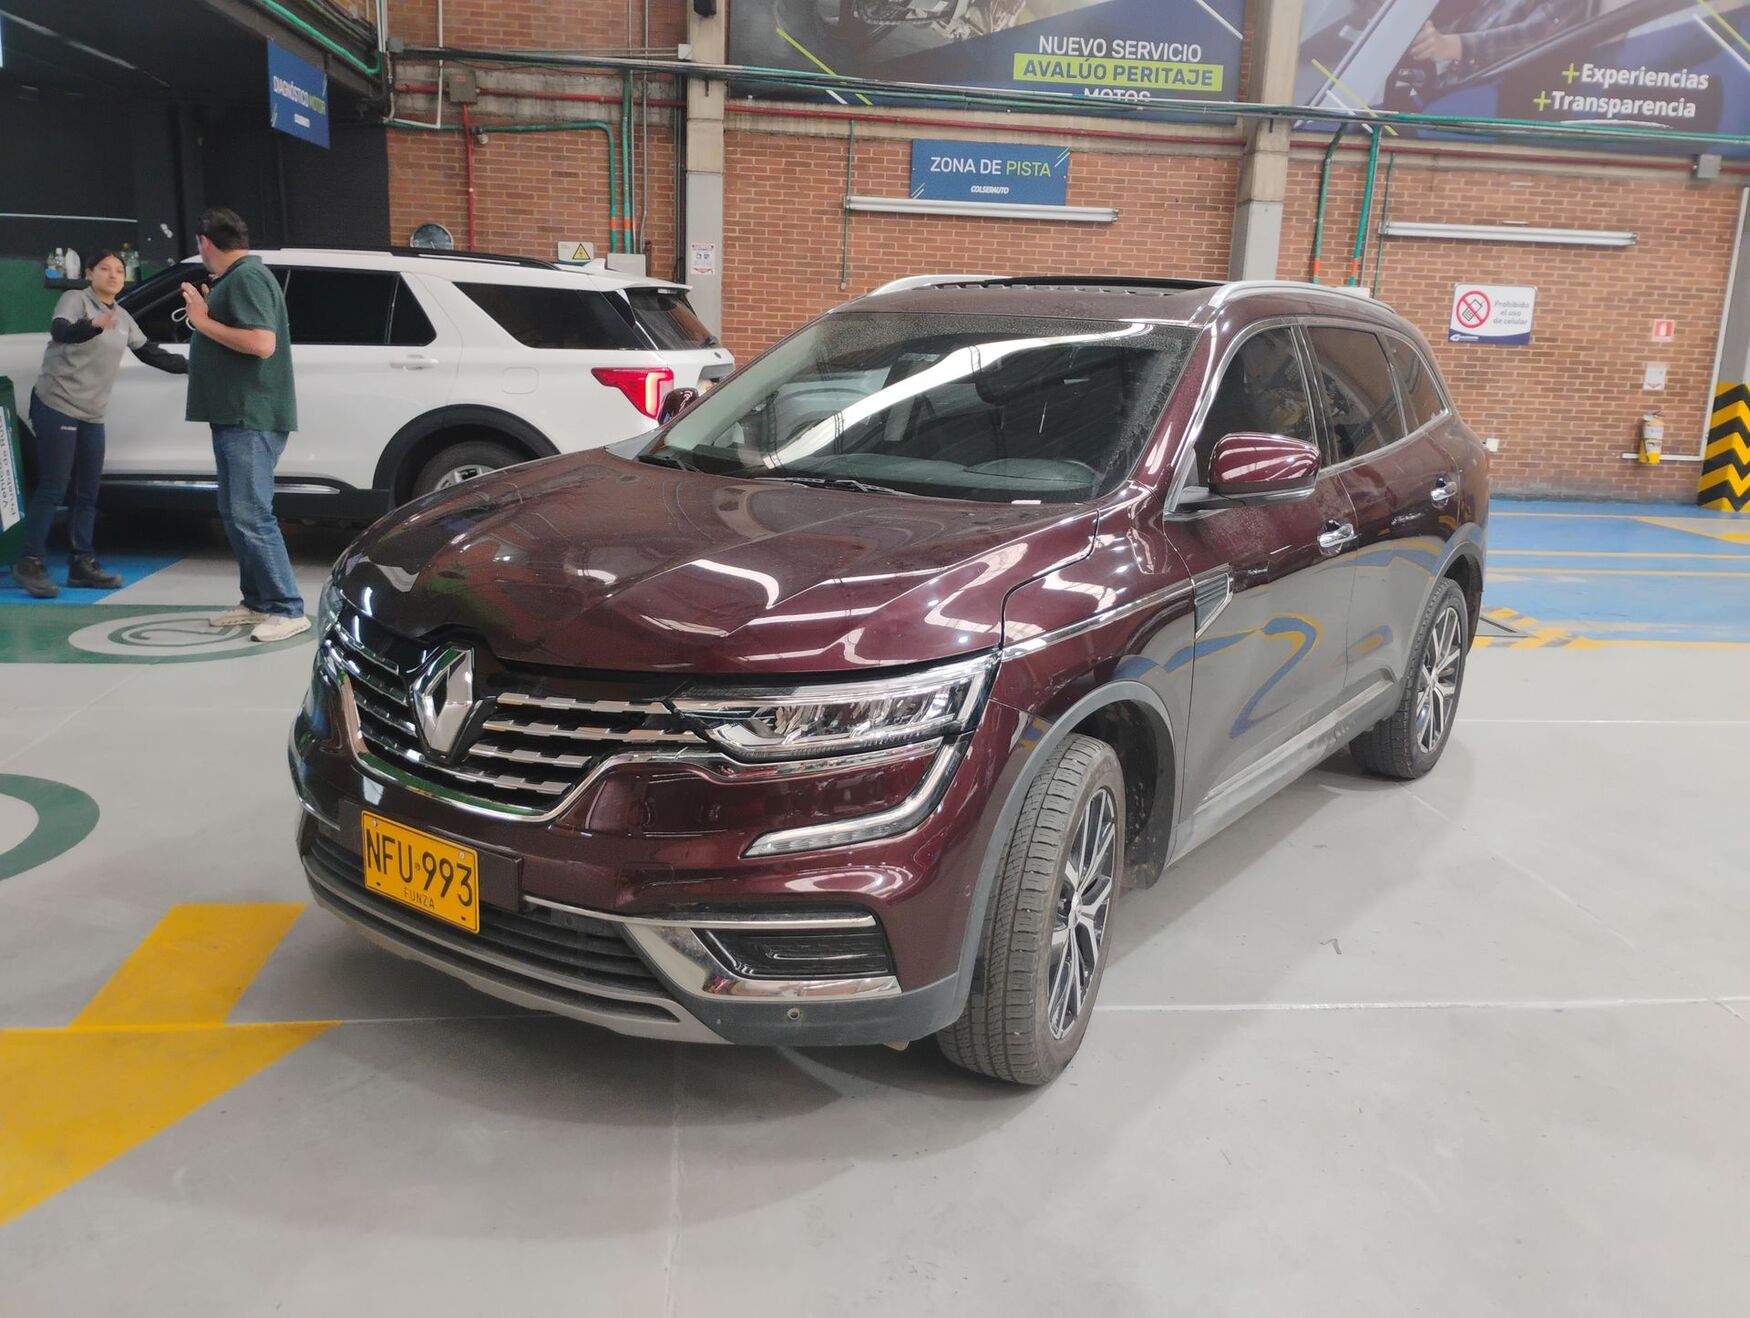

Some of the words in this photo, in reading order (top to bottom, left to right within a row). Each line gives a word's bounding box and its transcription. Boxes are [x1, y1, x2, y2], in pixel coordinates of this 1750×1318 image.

[1039, 35, 1107, 56] NUEVO
[1111, 39, 1202, 62] SERVICIO
[1023, 58, 1107, 80] AVALÚO
[1113, 65, 1213, 87] PERITAJE
[930, 156, 976, 173] ZONA
[980, 159, 1002, 175] DE
[1006, 160, 1051, 177] PISTA
[404, 887, 435, 910] FUNZA
